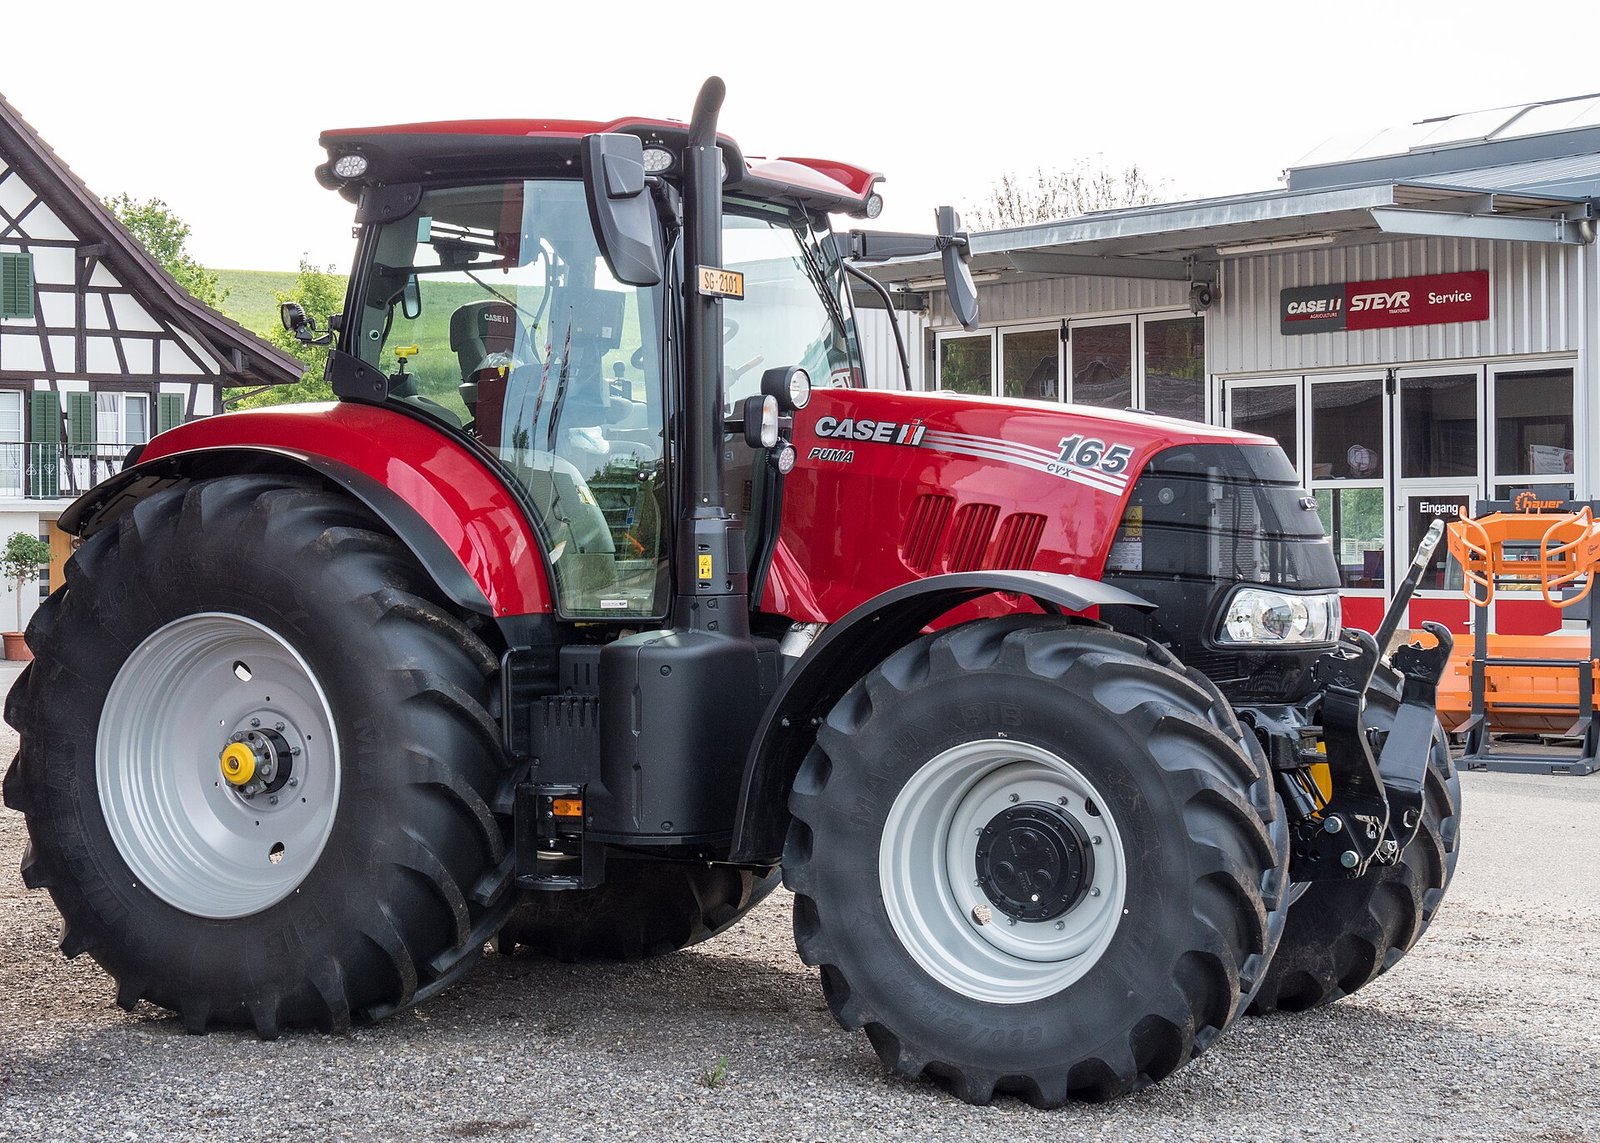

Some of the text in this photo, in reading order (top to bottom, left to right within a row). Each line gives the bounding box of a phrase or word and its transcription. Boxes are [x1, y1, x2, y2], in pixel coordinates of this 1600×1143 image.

[1349, 291, 1411, 312] STEYR
[1428, 290, 1472, 305] Service
[1287, 299, 1327, 315] CASE
[484, 313, 502, 323] CASE
[815, 416, 897, 443] CASE
[807, 447, 855, 463] PUMA
[1058, 433, 1135, 476] 165
[1046, 463, 1072, 477] CVX
[1419, 502, 1459, 516] Eingang
[1523, 496, 1564, 509] hauer
